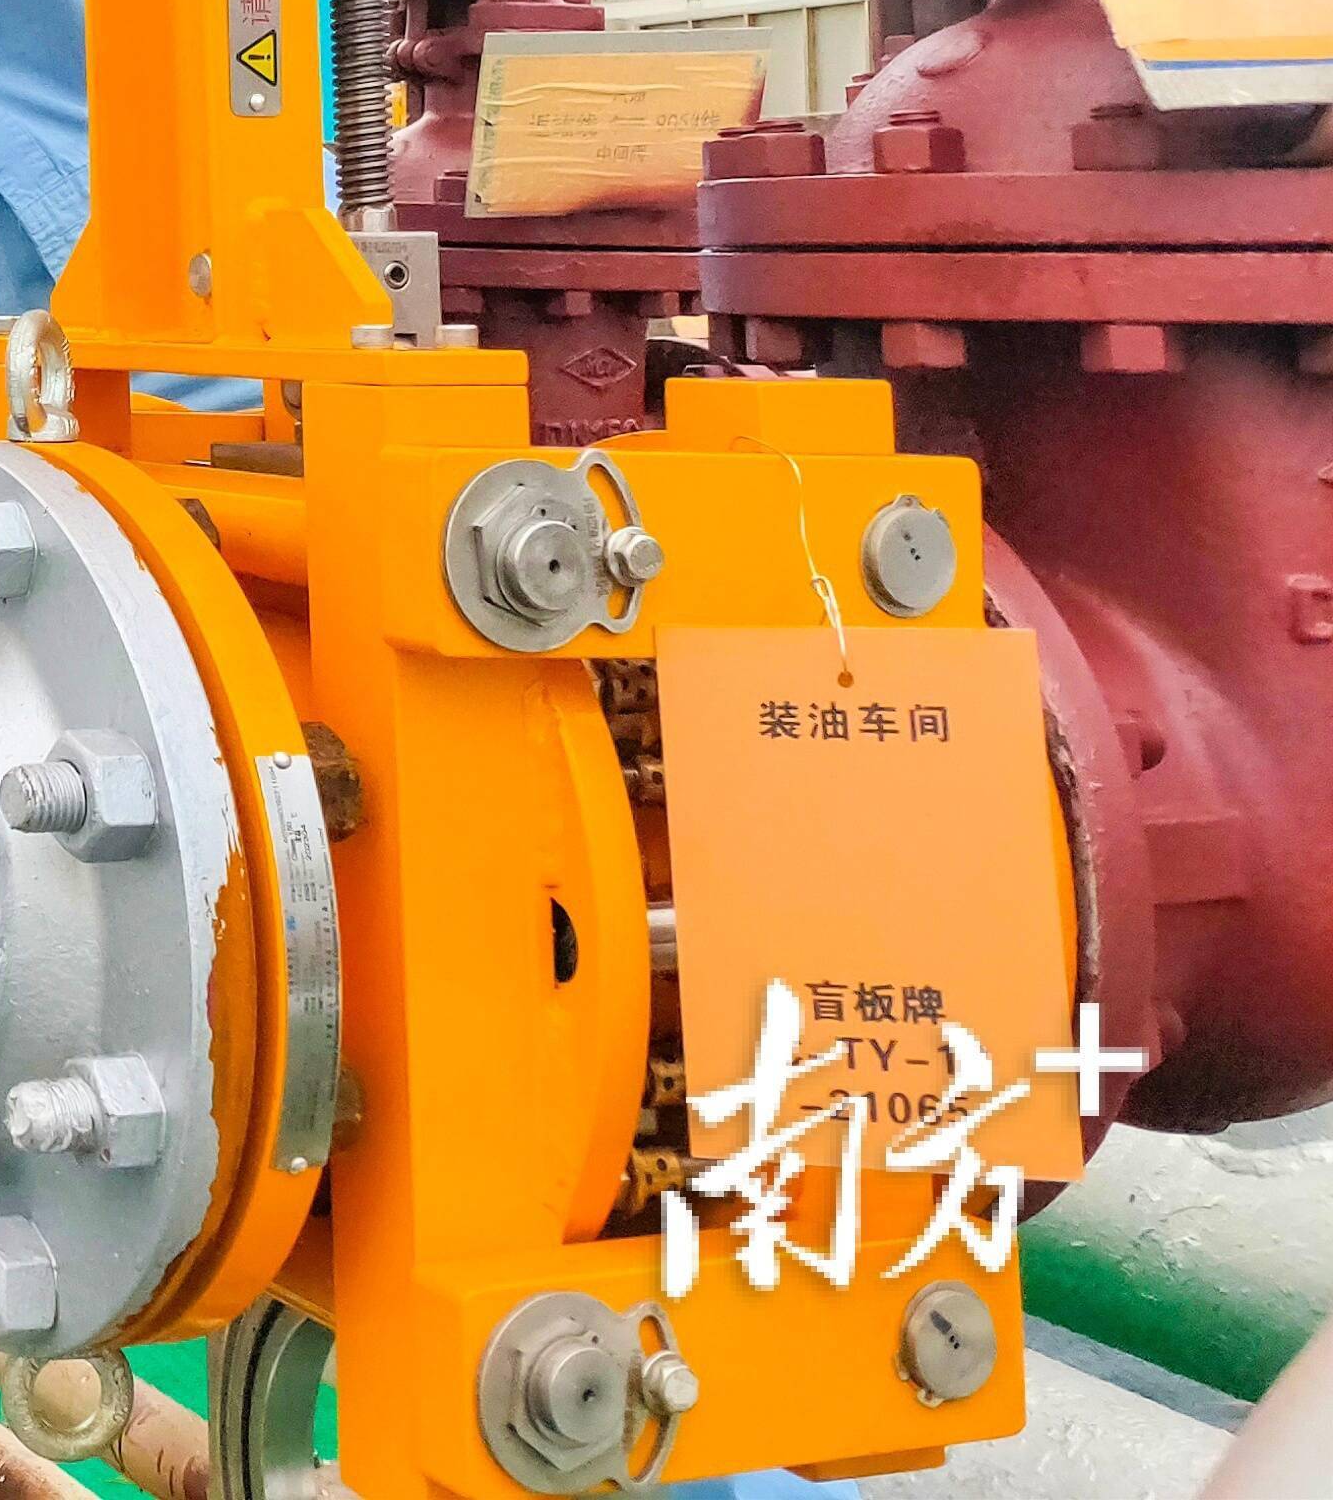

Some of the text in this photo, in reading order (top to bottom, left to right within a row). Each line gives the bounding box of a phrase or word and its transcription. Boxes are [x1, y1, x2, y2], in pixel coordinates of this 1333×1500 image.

[758, 700, 951, 743] 装油车间
[804, 980, 948, 1025] 盲板牌
